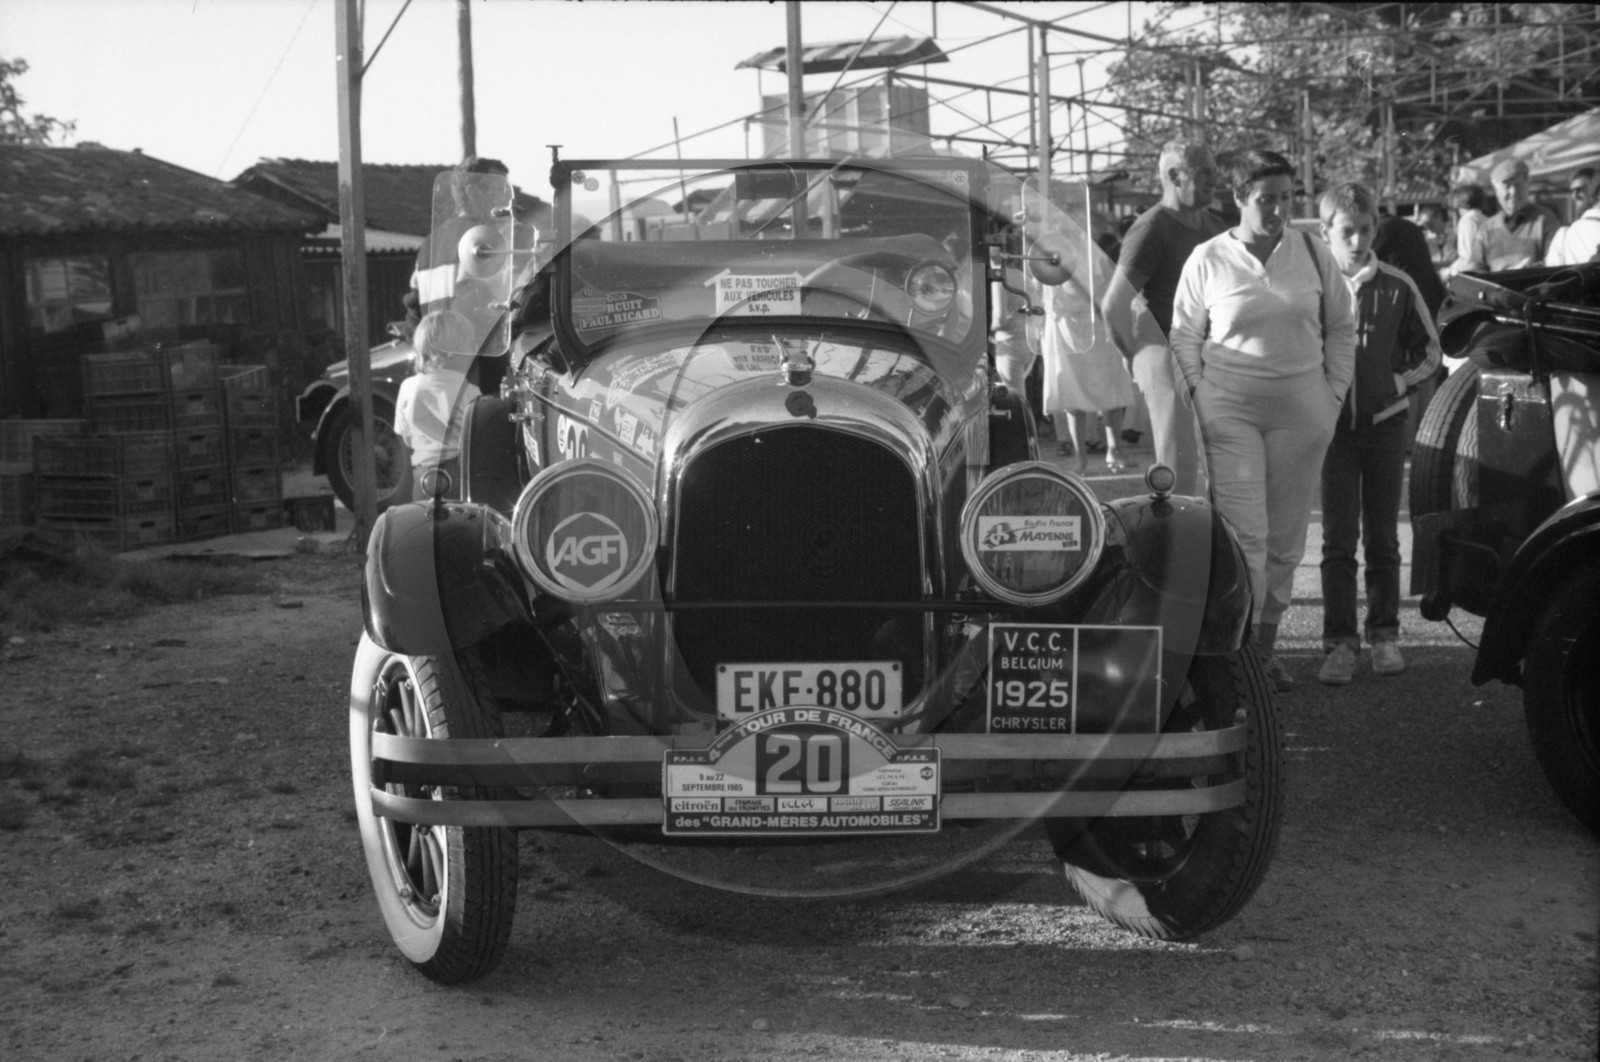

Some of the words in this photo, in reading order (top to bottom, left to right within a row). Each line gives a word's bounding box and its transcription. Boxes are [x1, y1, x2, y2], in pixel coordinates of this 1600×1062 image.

[720, 278, 732, 289] NE
[736, 278, 753, 289] PAS
[756, 277, 797, 289] TOUCHER
[724, 291, 742, 302] AUX
[746, 290, 795, 302] VEHICULES
[613, 307, 660, 324] RICARD
[1024, 519, 1047, 527] Radio
[1049, 519, 1074, 527] france
[1019, 531, 1075, 542] MAYENNE
[553, 534, 621, 567] AGF
[1004, 631, 1068, 652] V.C.C.
[1001, 656, 1063, 670] BELGIUM
[995, 680, 1069, 708] 1925
[992, 716, 1067, 730] CHRYSLER
[735, 711, 787, 738] TOUR
[794, 710, 821, 722] DE
[826, 713, 898, 760] FRANCE
[765, 734, 842, 793] 20
[699, 773, 704, 781] 9
[715, 773, 724, 781] 22
[681, 784, 726, 792] SEPTEMBRE
[727, 784, 743, 792] 1985
[674, 800, 719, 811] citroën
[888, 798, 926, 807] SEALINK
[675, 815, 700, 828] des
